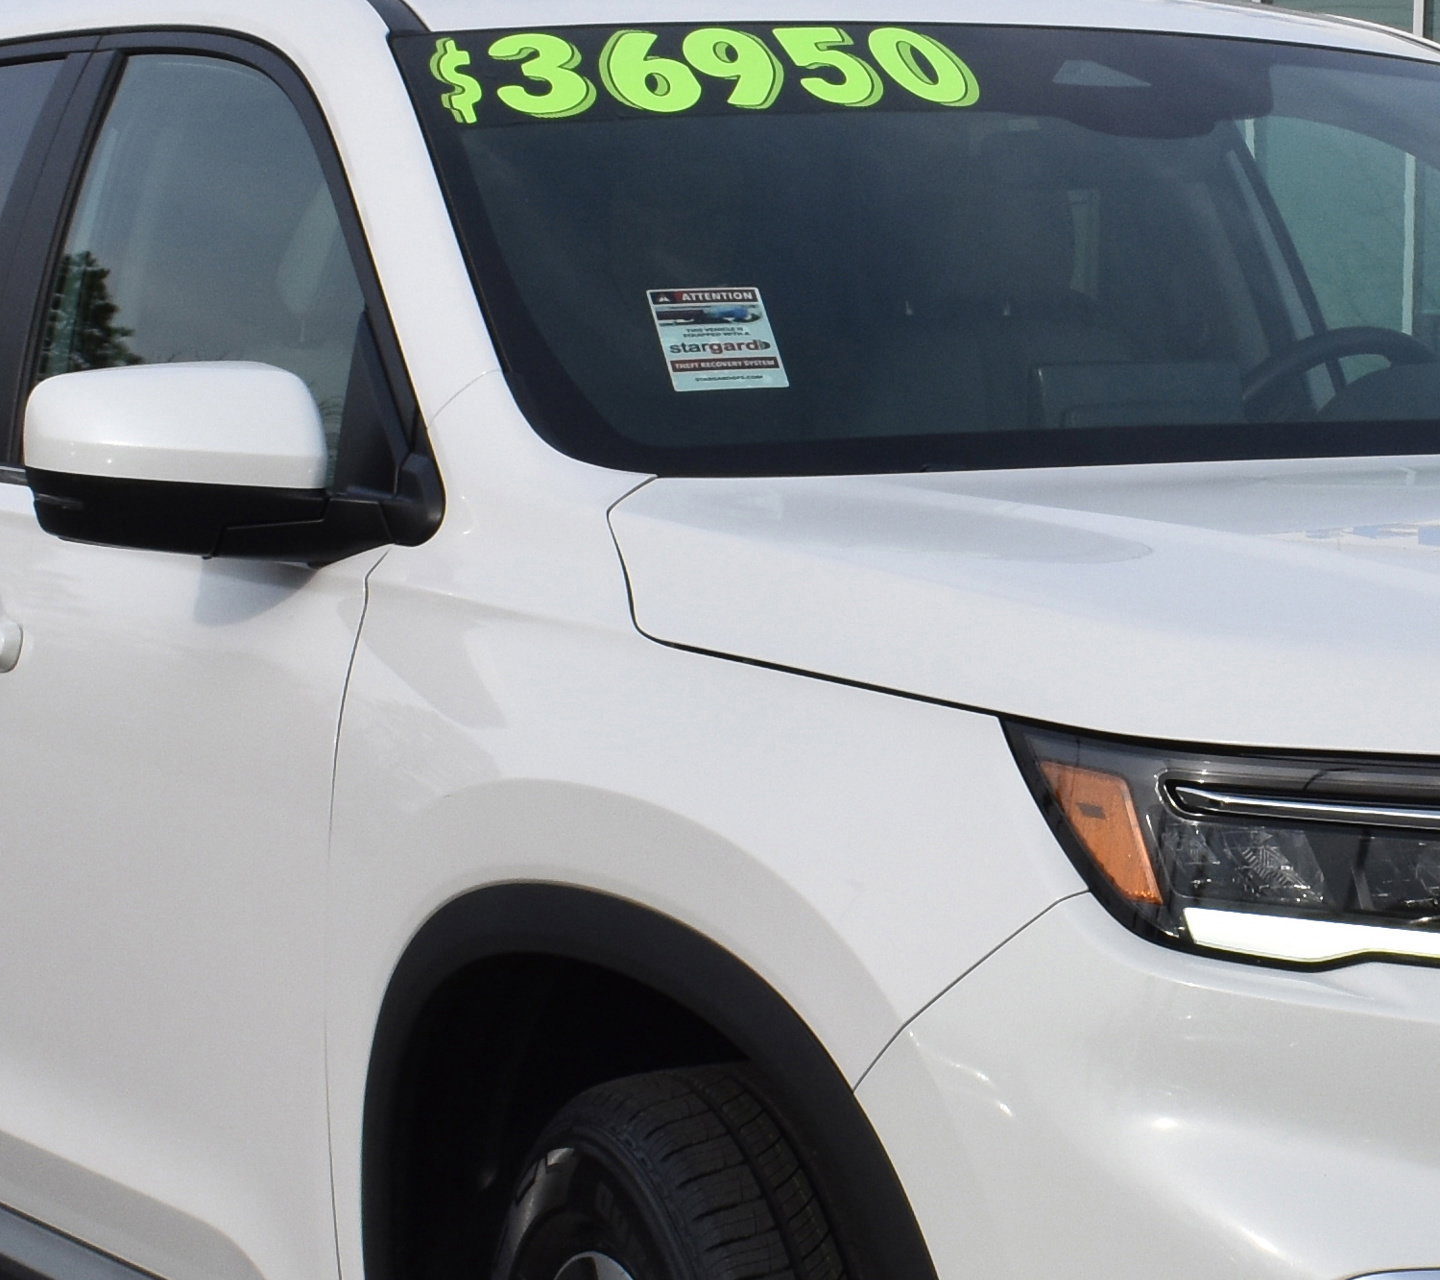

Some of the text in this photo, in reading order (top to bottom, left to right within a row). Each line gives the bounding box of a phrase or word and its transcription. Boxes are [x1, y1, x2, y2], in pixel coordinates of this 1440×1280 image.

[430, 27, 980, 124] $36950
[681, 291, 753, 301] ATTENTION
[669, 339, 759, 355] stargard
[675, 359, 775, 369] THEFT RECOVERY SYSTEM
